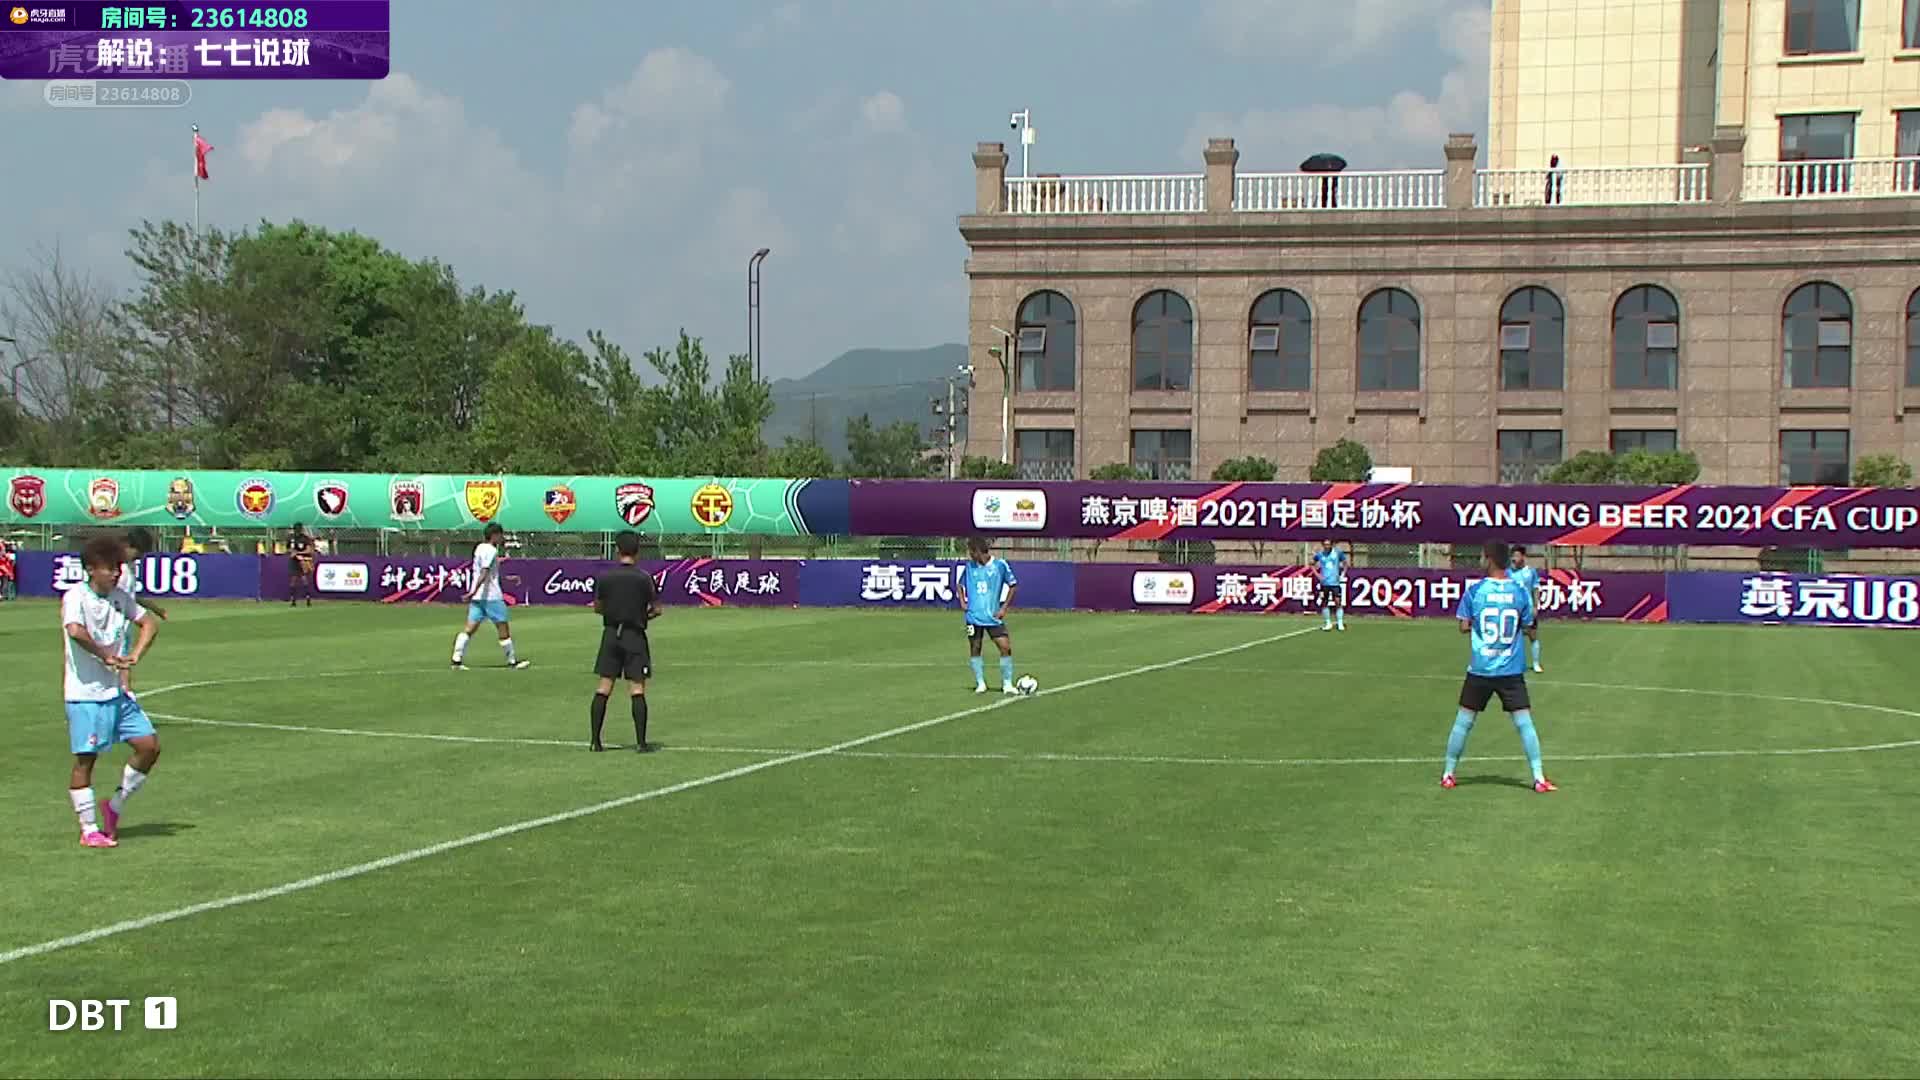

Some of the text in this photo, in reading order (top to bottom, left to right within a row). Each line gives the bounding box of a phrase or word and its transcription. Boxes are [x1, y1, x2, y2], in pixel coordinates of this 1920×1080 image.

[1081, 496, 1422, 530] 燕京啤酒2021中国足协杯
[1453, 502, 1918, 532] YANJING BEER 2021 CFA CUP
[381, 564, 471, 592] 种子计划
[545, 569, 595, 594] Game
[685, 569, 781, 595] 全民足球
[1740, 577, 1919, 623] 燕京U8
